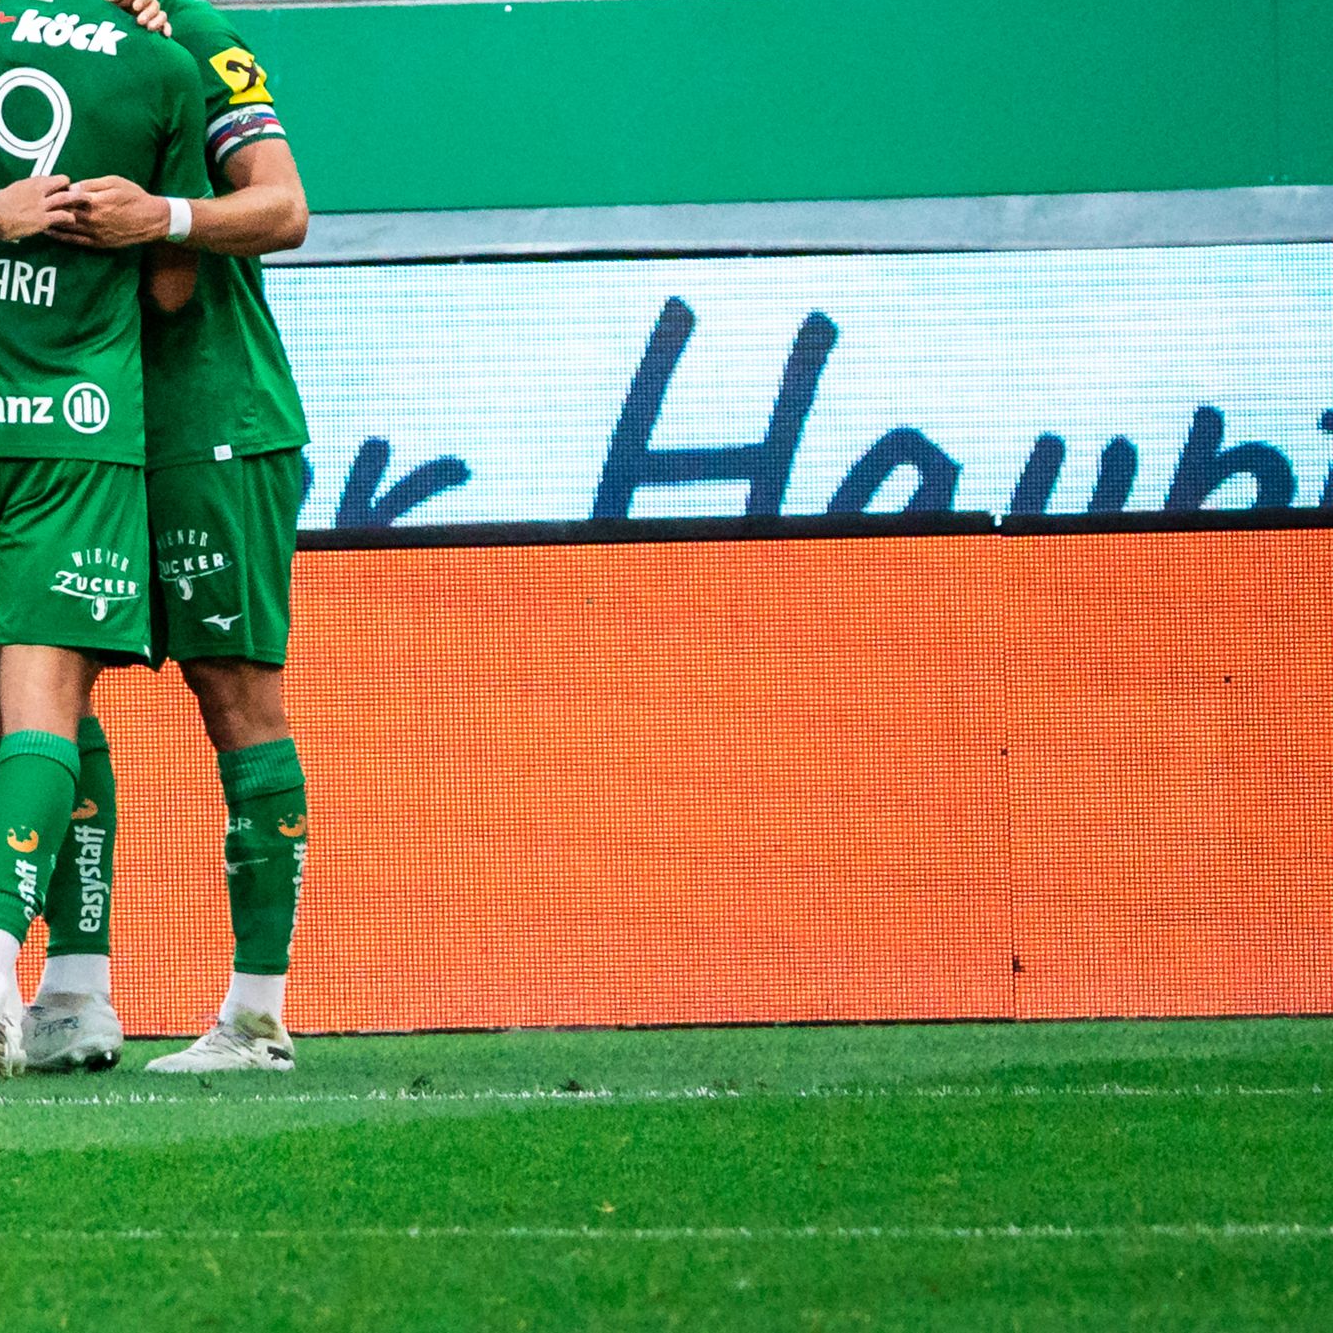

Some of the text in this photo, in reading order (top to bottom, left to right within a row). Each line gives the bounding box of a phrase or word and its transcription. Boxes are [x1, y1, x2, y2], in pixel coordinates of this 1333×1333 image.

[12, 9, 129, 56] köck
[159, 552, 225, 576] UCKER
[51, 570, 138, 596] ZUCKER
[75, 824, 109, 933] easystaff
